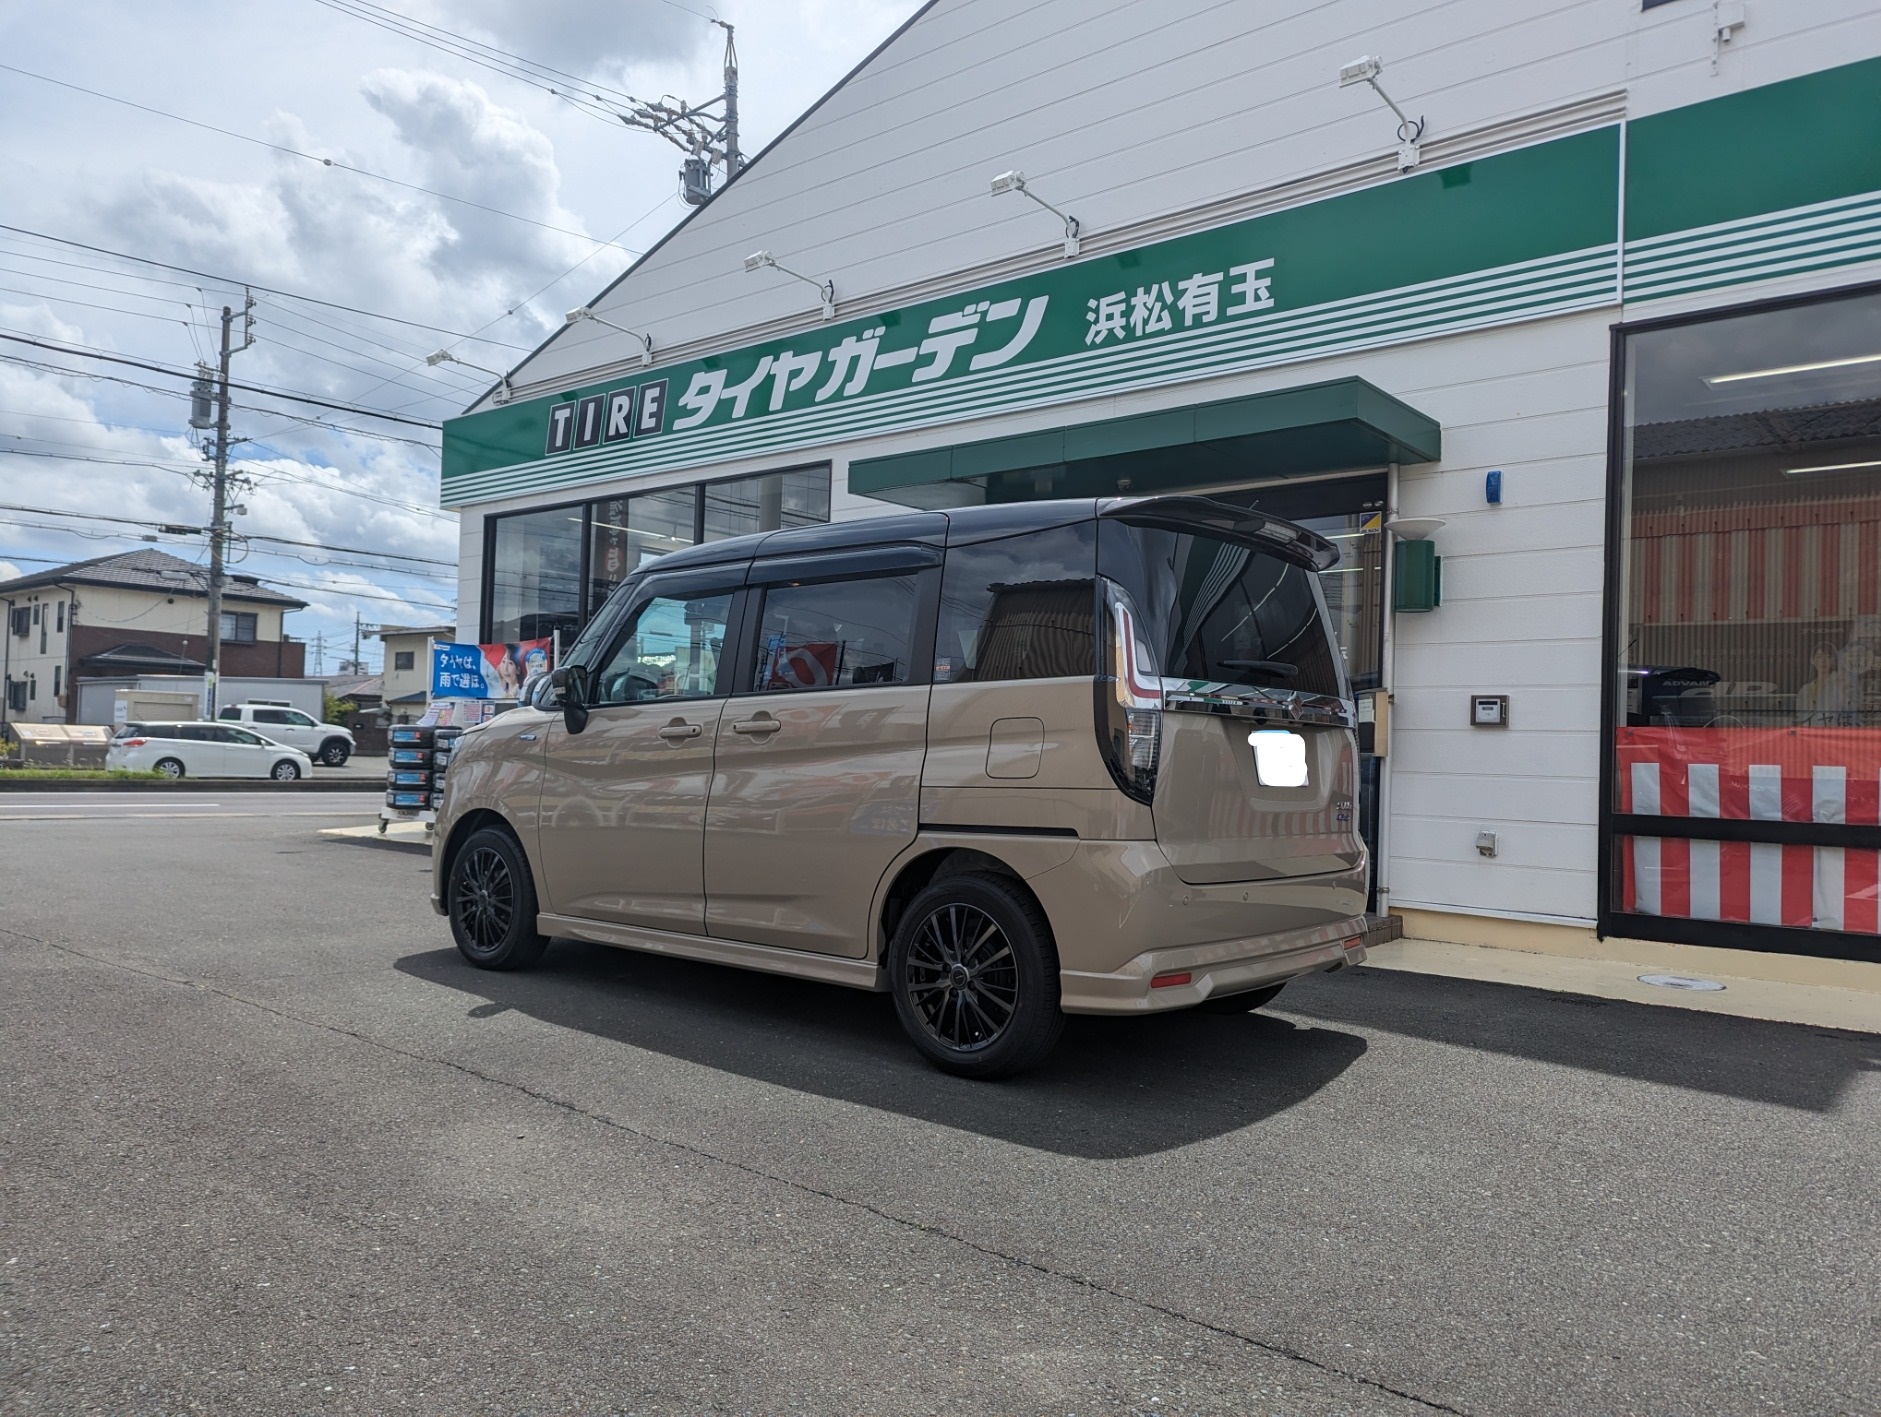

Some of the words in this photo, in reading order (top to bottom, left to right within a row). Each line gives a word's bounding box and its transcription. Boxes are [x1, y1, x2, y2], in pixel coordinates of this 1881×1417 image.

[553, 386, 661, 448] TIRE
[672, 295, 1049, 430] タイヤガーデン
[1085, 258, 1275, 347] 浜松有玉
[440, 653, 476, 670] タイヤは、
